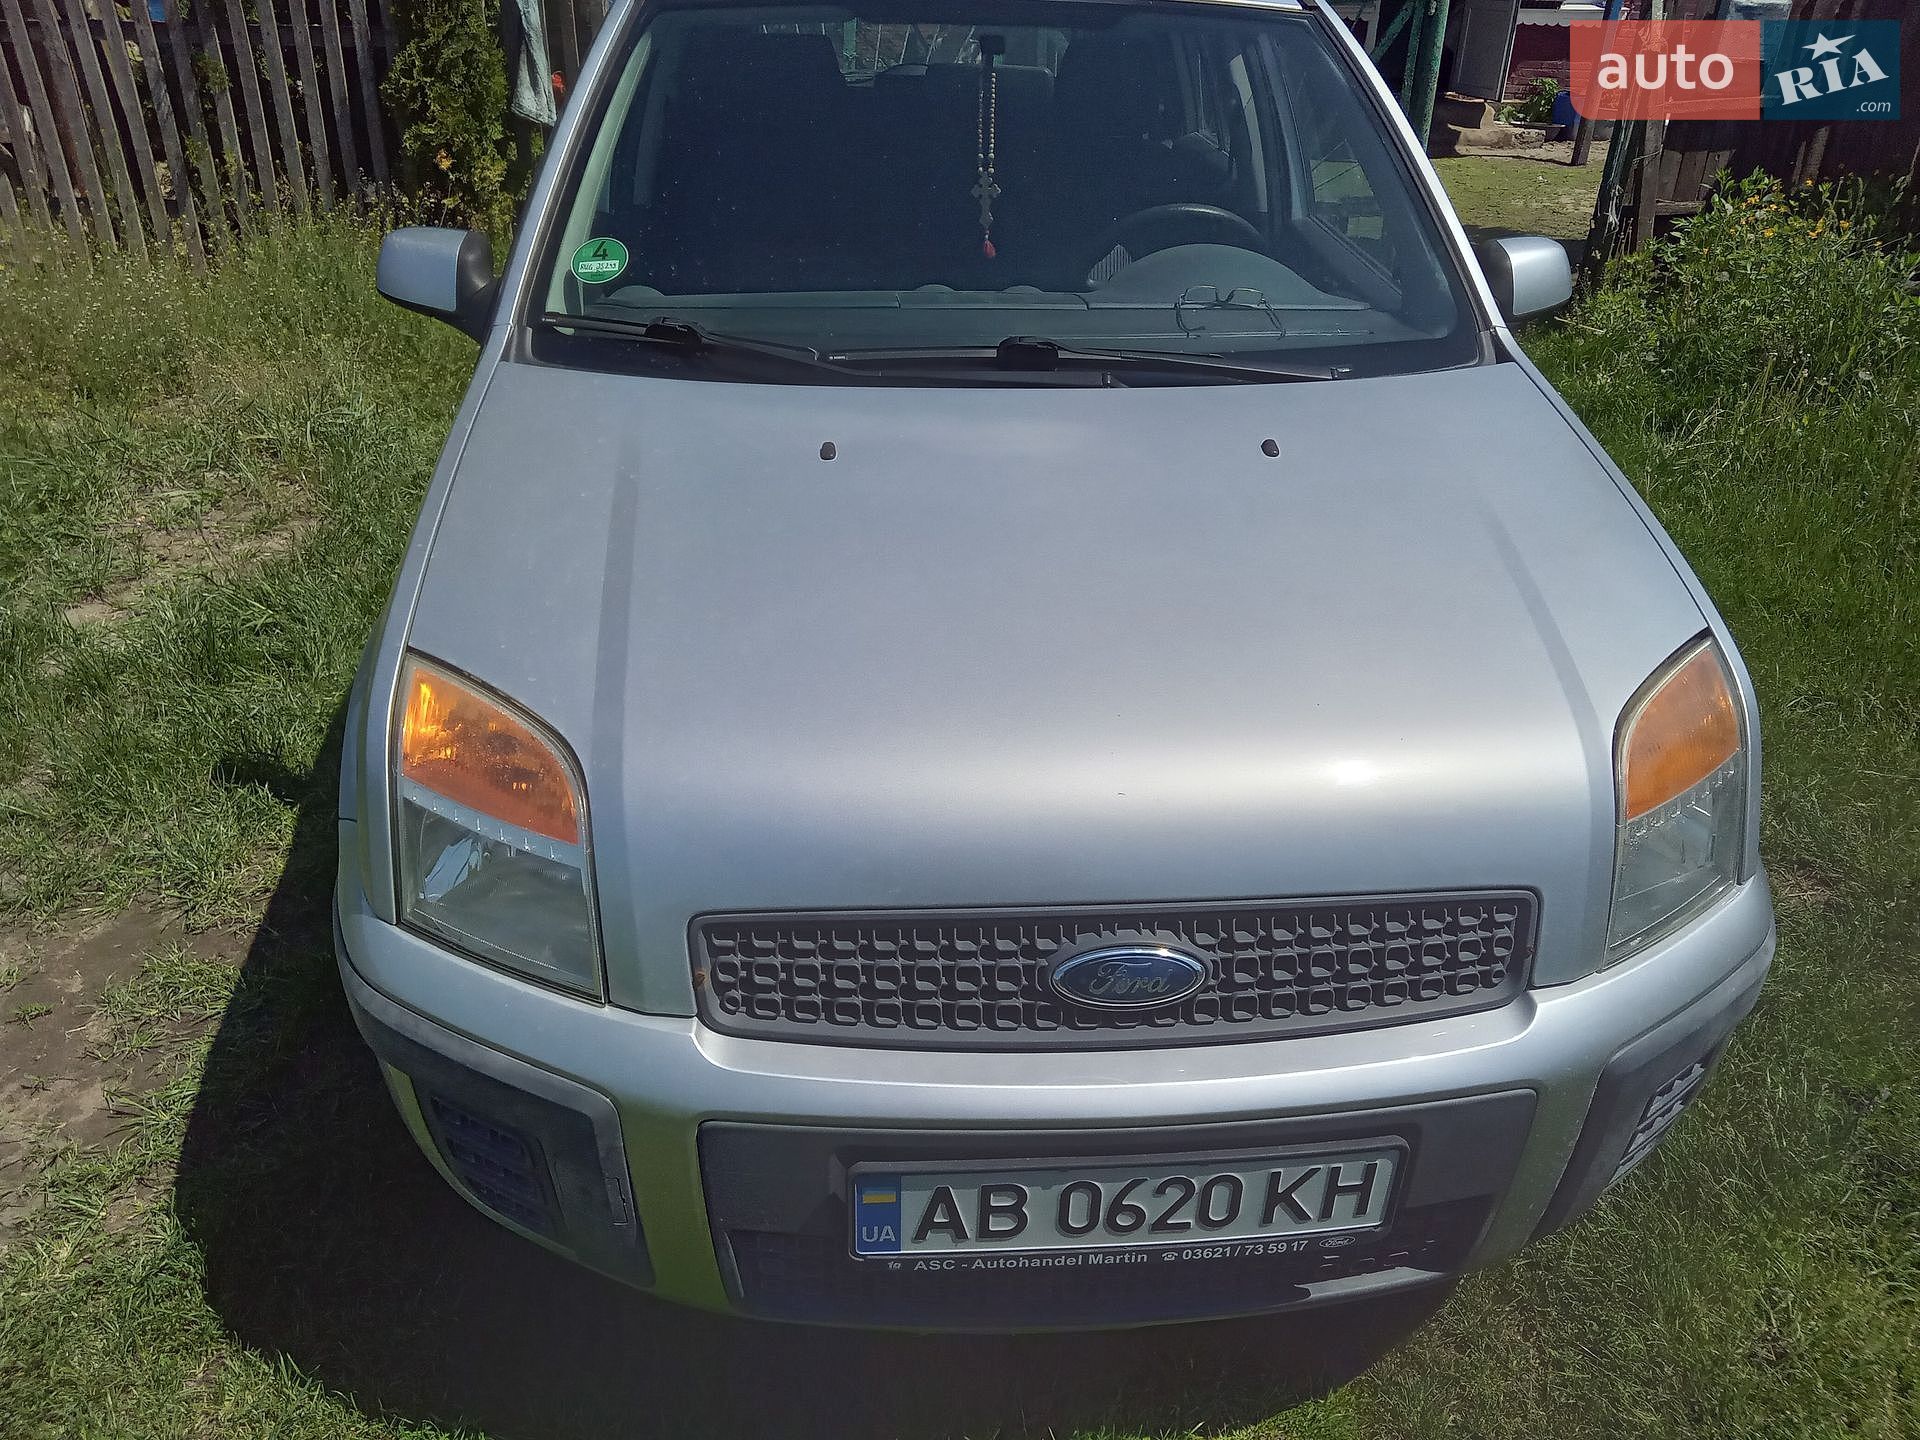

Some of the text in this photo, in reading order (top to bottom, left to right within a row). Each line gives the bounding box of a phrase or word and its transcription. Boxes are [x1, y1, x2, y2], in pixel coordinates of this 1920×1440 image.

[591, 240, 608, 260] 4
[1088, 961, 1174, 995] Ford
[912, 1161, 1379, 1242] AB 0620 KH
[862, 1225, 896, 1242] UA
[913, 1259, 956, 1271] ASC
[971, 1253, 1082, 1270] Autohandel
[1088, 1252, 1148, 1265] Martin
